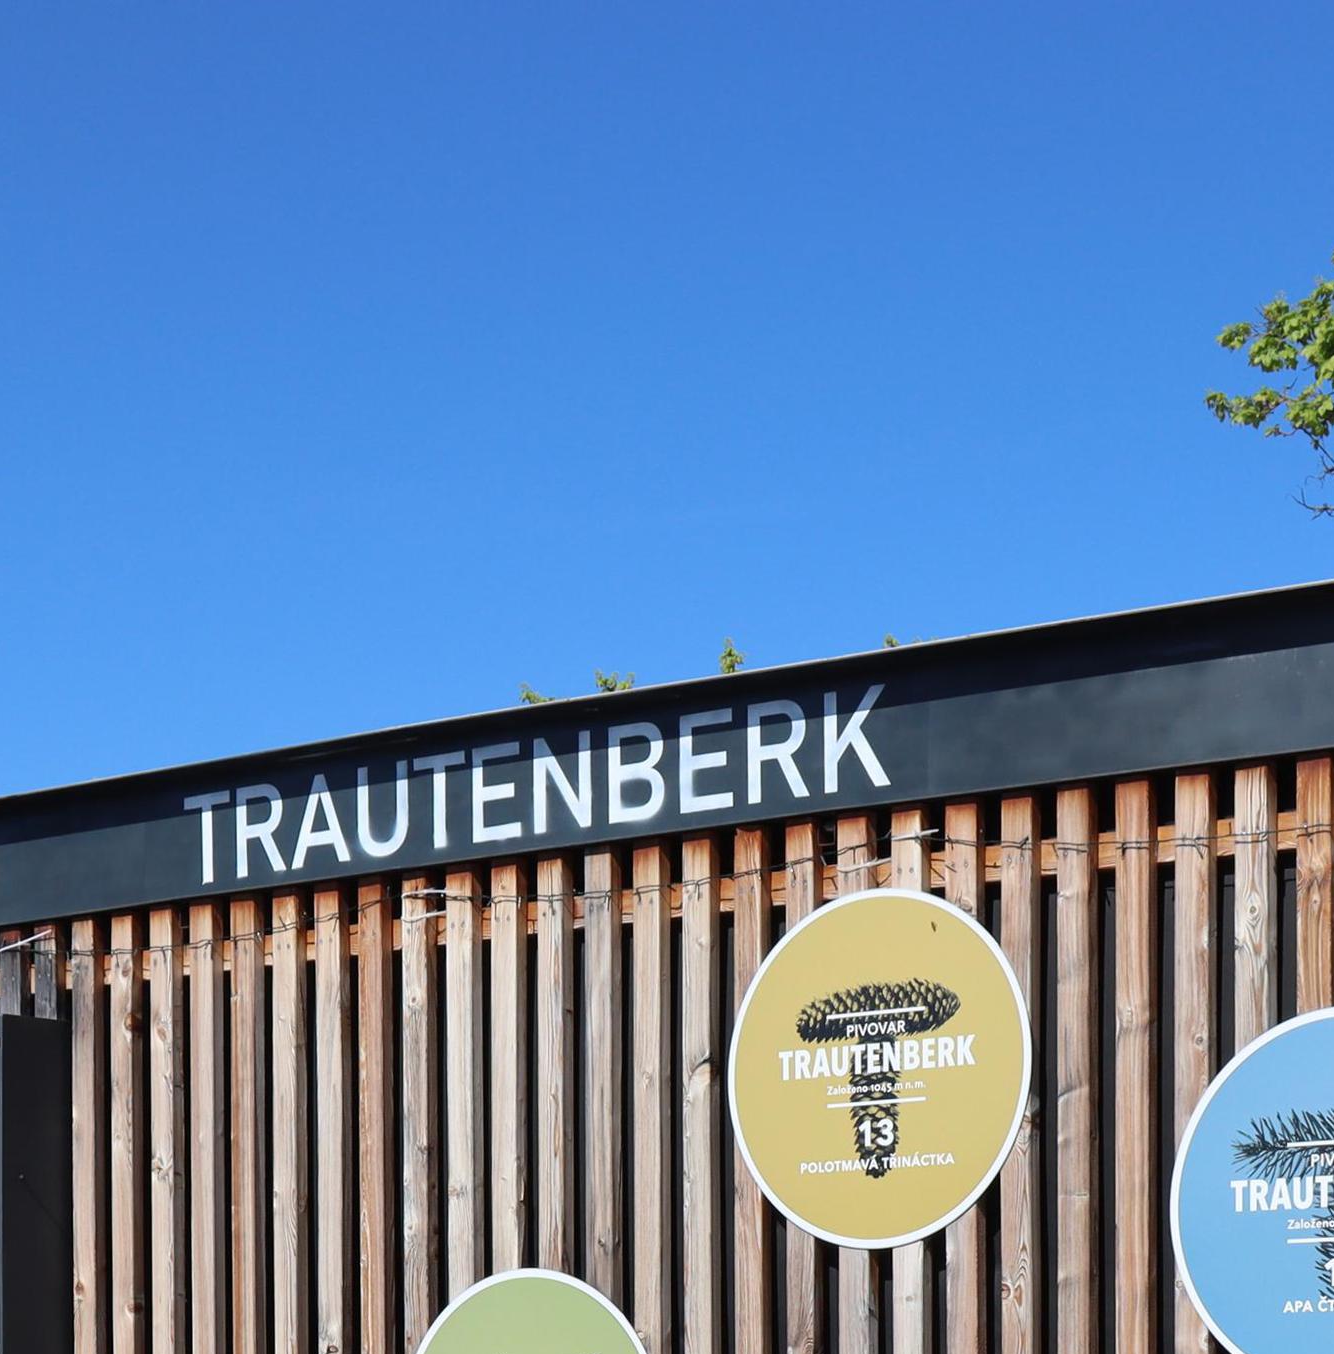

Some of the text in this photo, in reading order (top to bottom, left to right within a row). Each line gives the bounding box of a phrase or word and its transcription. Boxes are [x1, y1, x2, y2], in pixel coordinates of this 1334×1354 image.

[184, 684, 893, 886] TRAUTENBERK
[846, 1020, 906, 1038] PIVOVAR
[779, 1034, 976, 1081] TRAUTENBERK
[827, 1085, 868, 1096] Založeno
[870, 1082, 892, 1093] 1045
[858, 1118, 895, 1148] 13
[800, 1152, 955, 1174] POLOTMAVÁ TŘINÁCTKA
[1287, 1218, 1334, 1230] Založeno
[1283, 1297, 1313, 1314] APA
